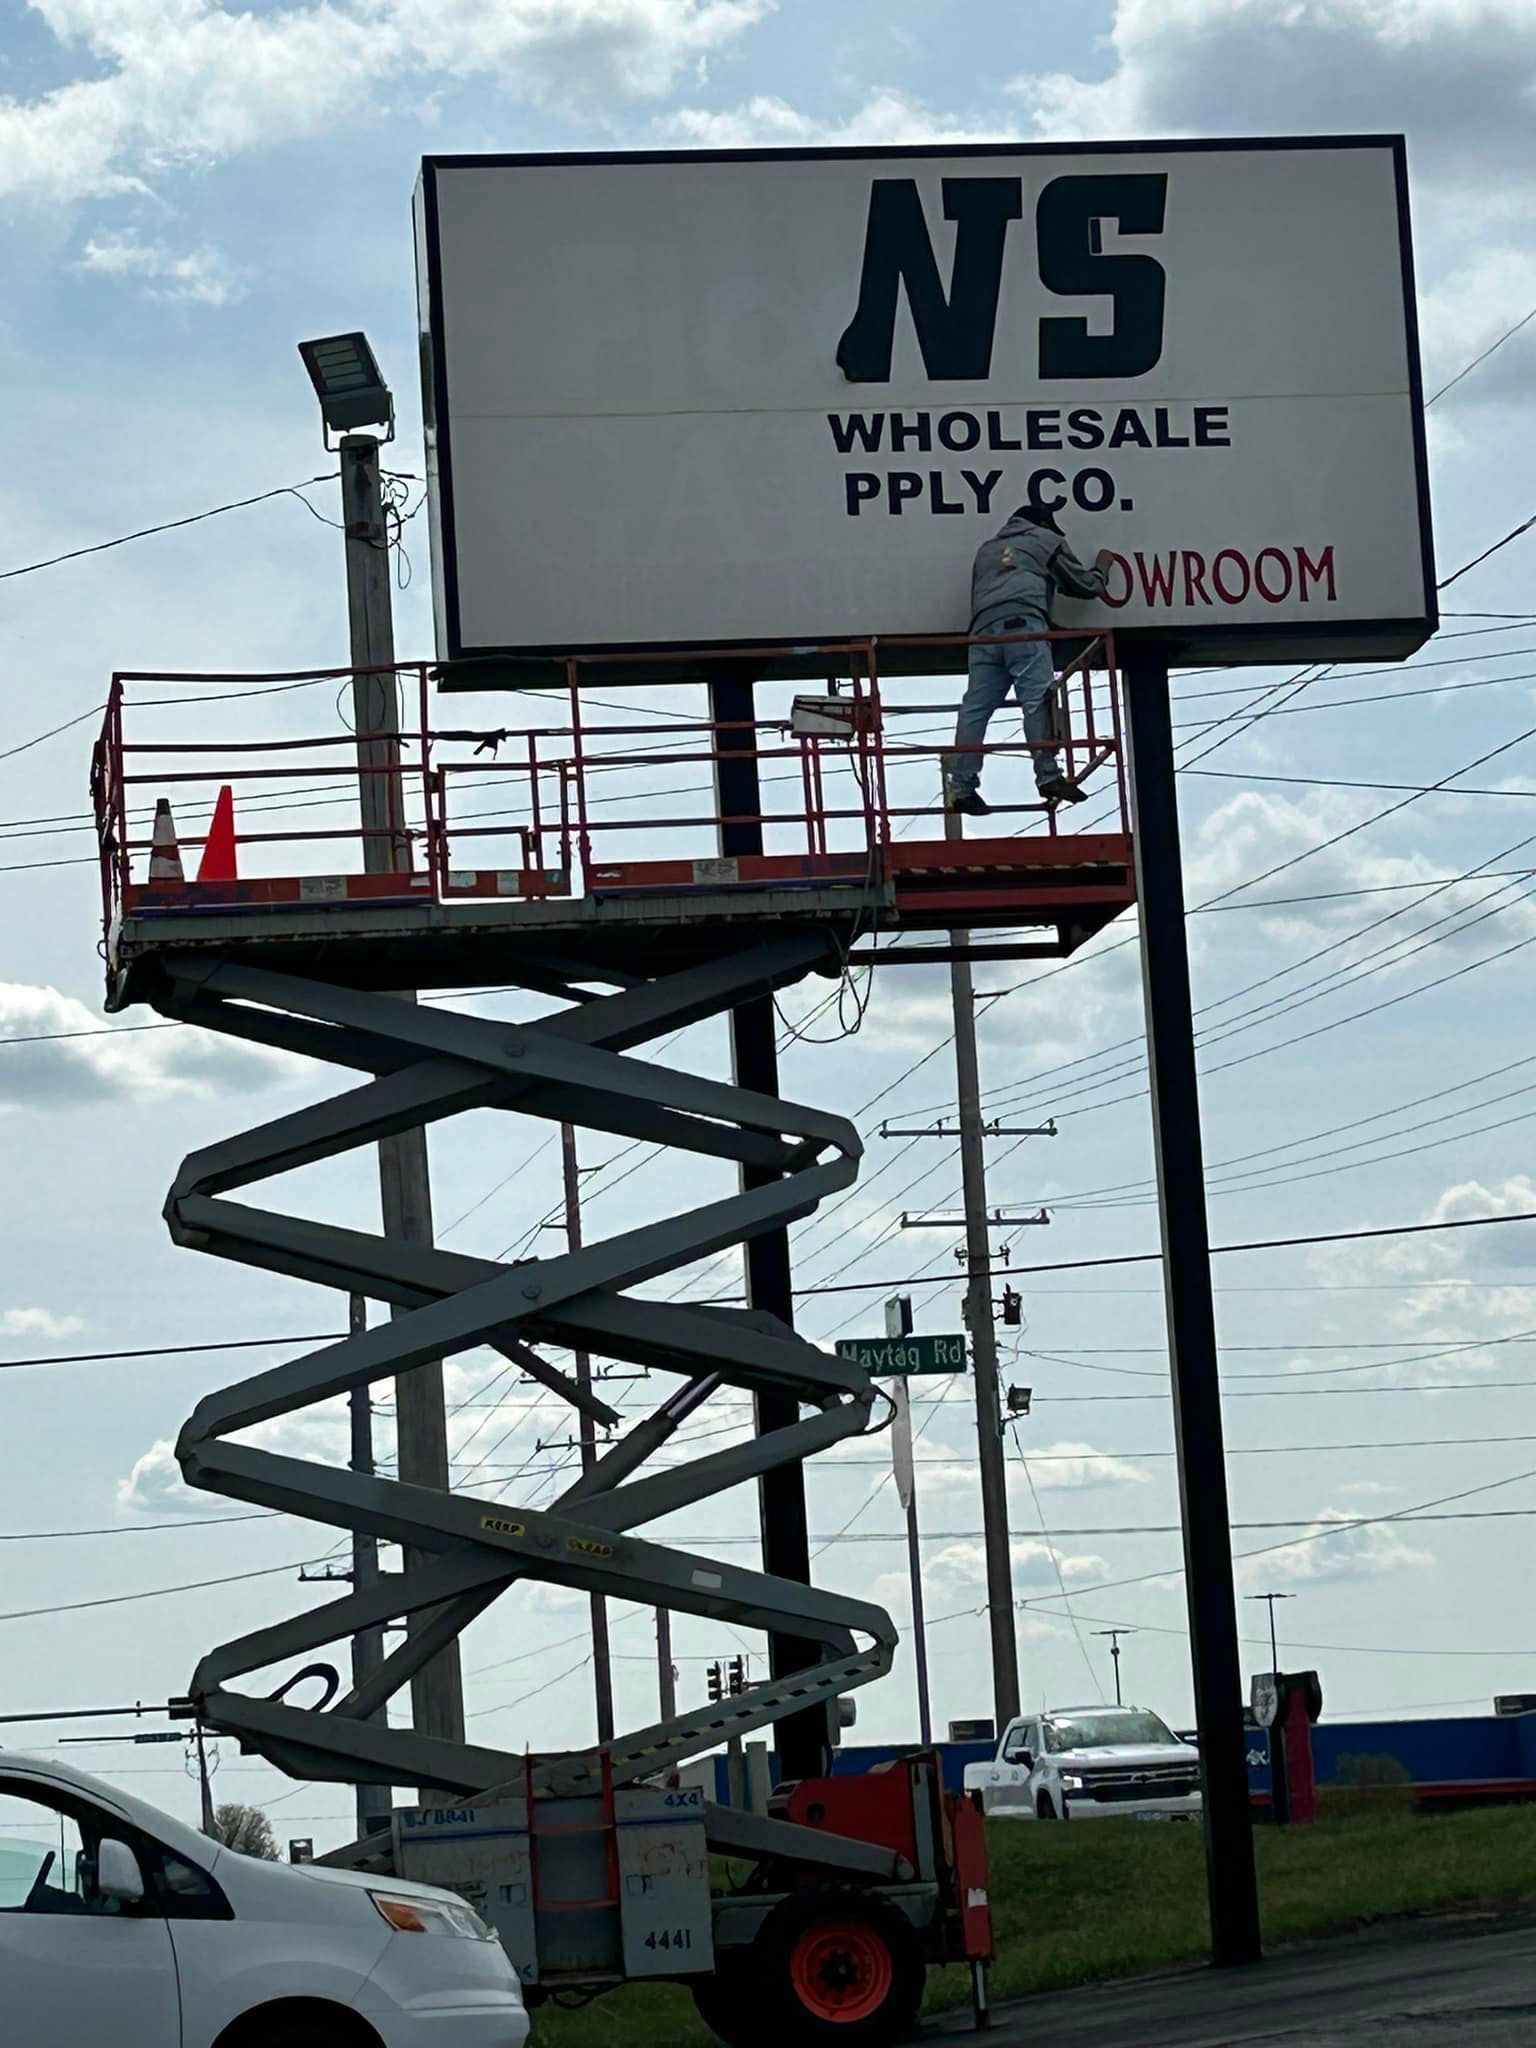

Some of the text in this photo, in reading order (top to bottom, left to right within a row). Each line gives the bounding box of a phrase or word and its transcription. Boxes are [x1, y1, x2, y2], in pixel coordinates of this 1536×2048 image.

[836, 173, 1168, 382] NS
[828, 407, 1231, 453] WHOLESALE
[845, 468, 1133, 515] PPLY CO.
[1098, 546, 1337, 609] OWROOM
[934, 1338, 962, 1365] Rd
[644, 1928, 691, 1951] 4441
